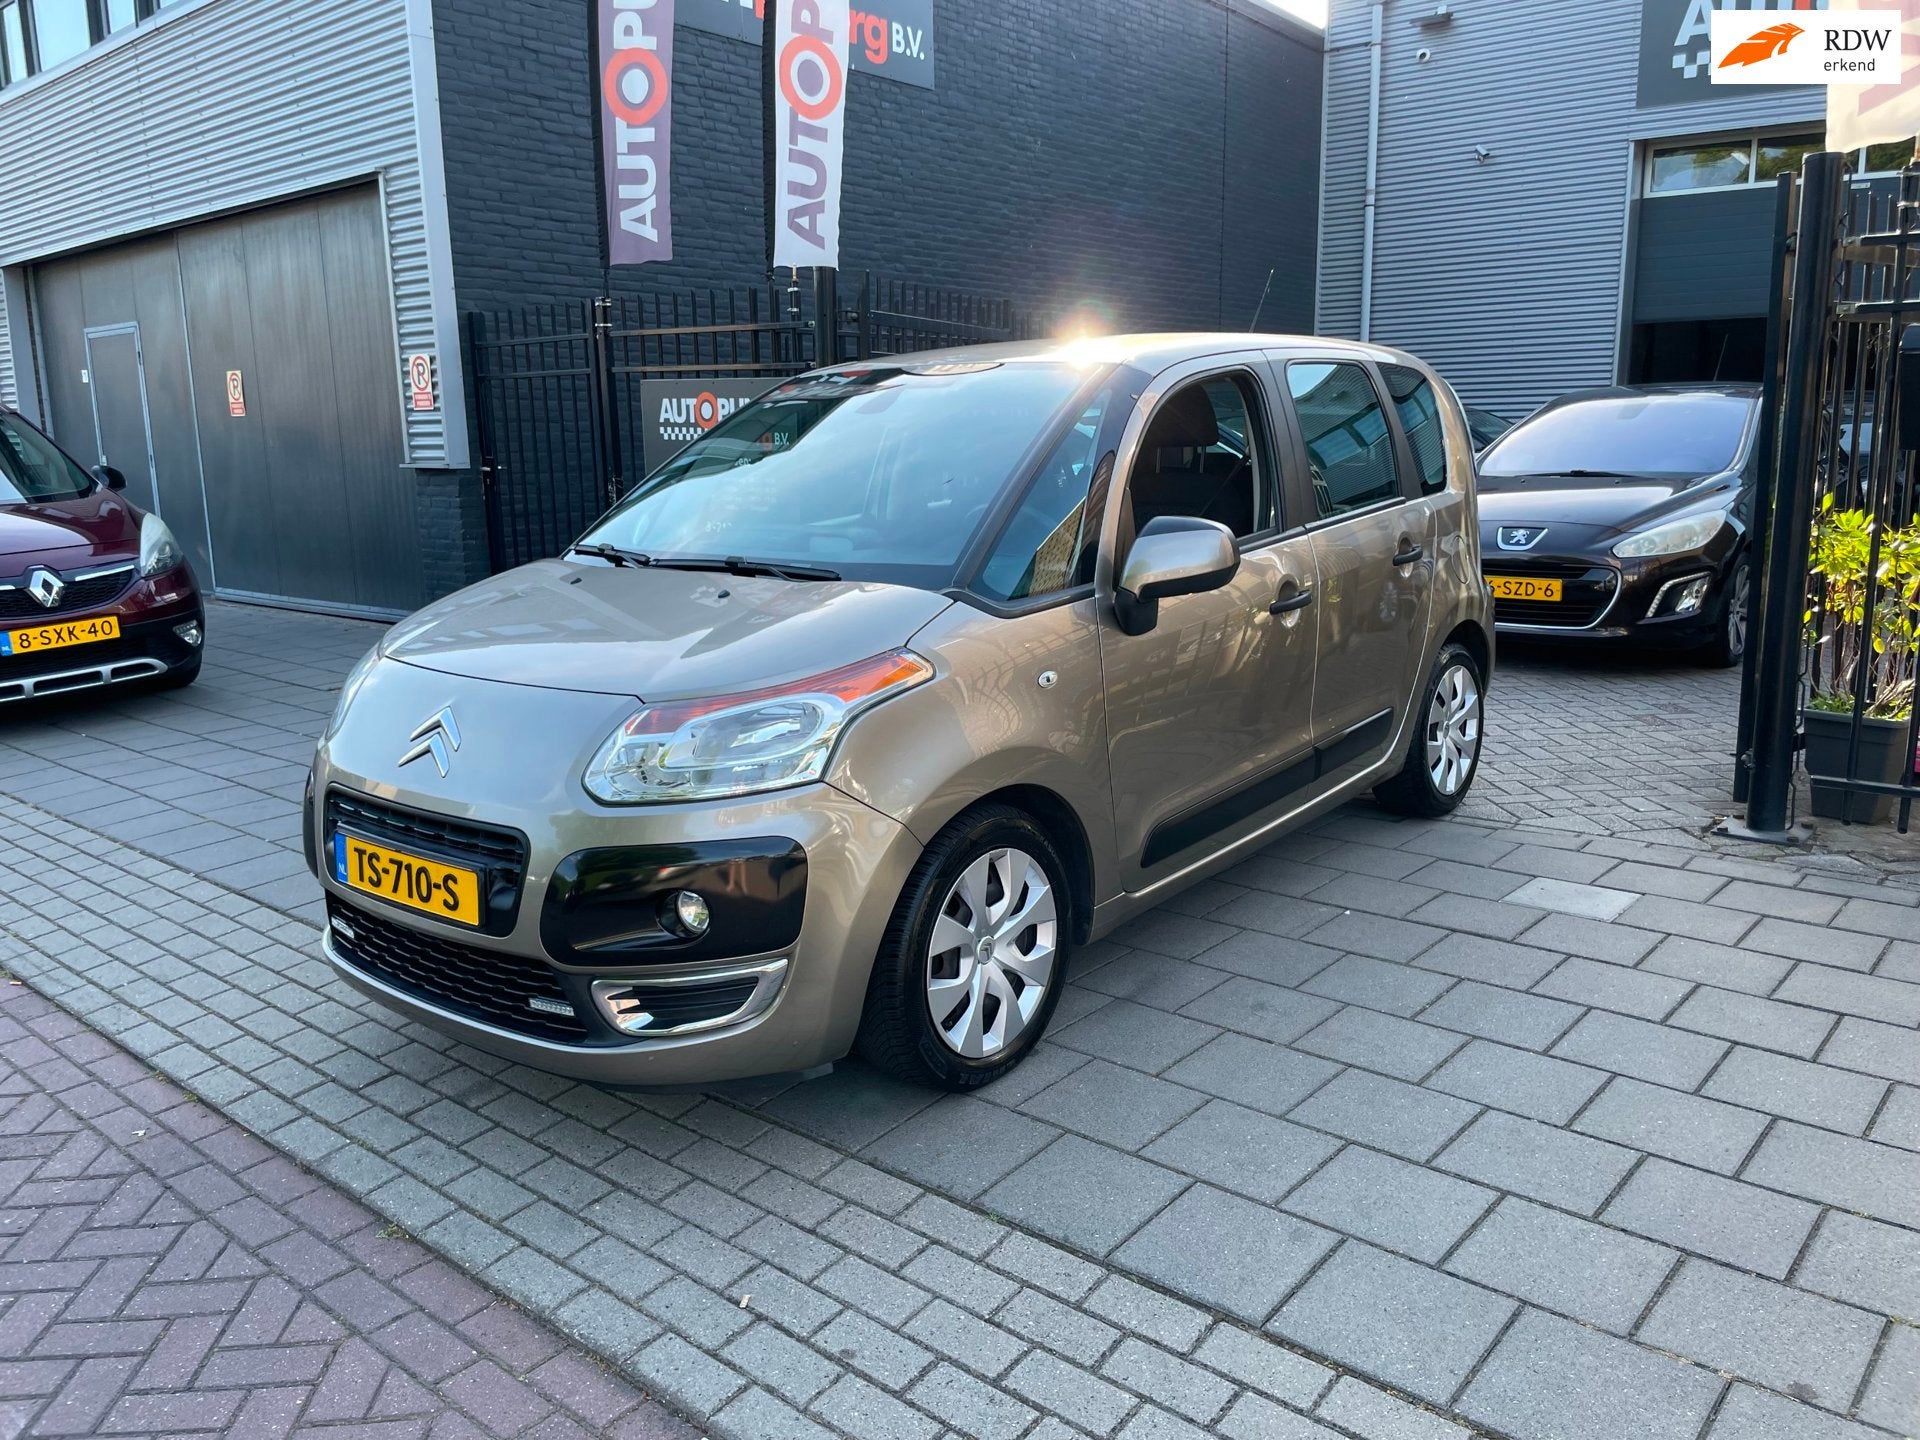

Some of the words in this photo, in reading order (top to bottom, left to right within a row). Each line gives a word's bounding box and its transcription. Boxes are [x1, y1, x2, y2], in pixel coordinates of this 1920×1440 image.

[892, 22, 926, 60] B.V.
[603, 0, 668, 244] AUTOP
[19, 620, 113, 649] 8-SXK-40
[353, 847, 460, 912] TS-710-S
